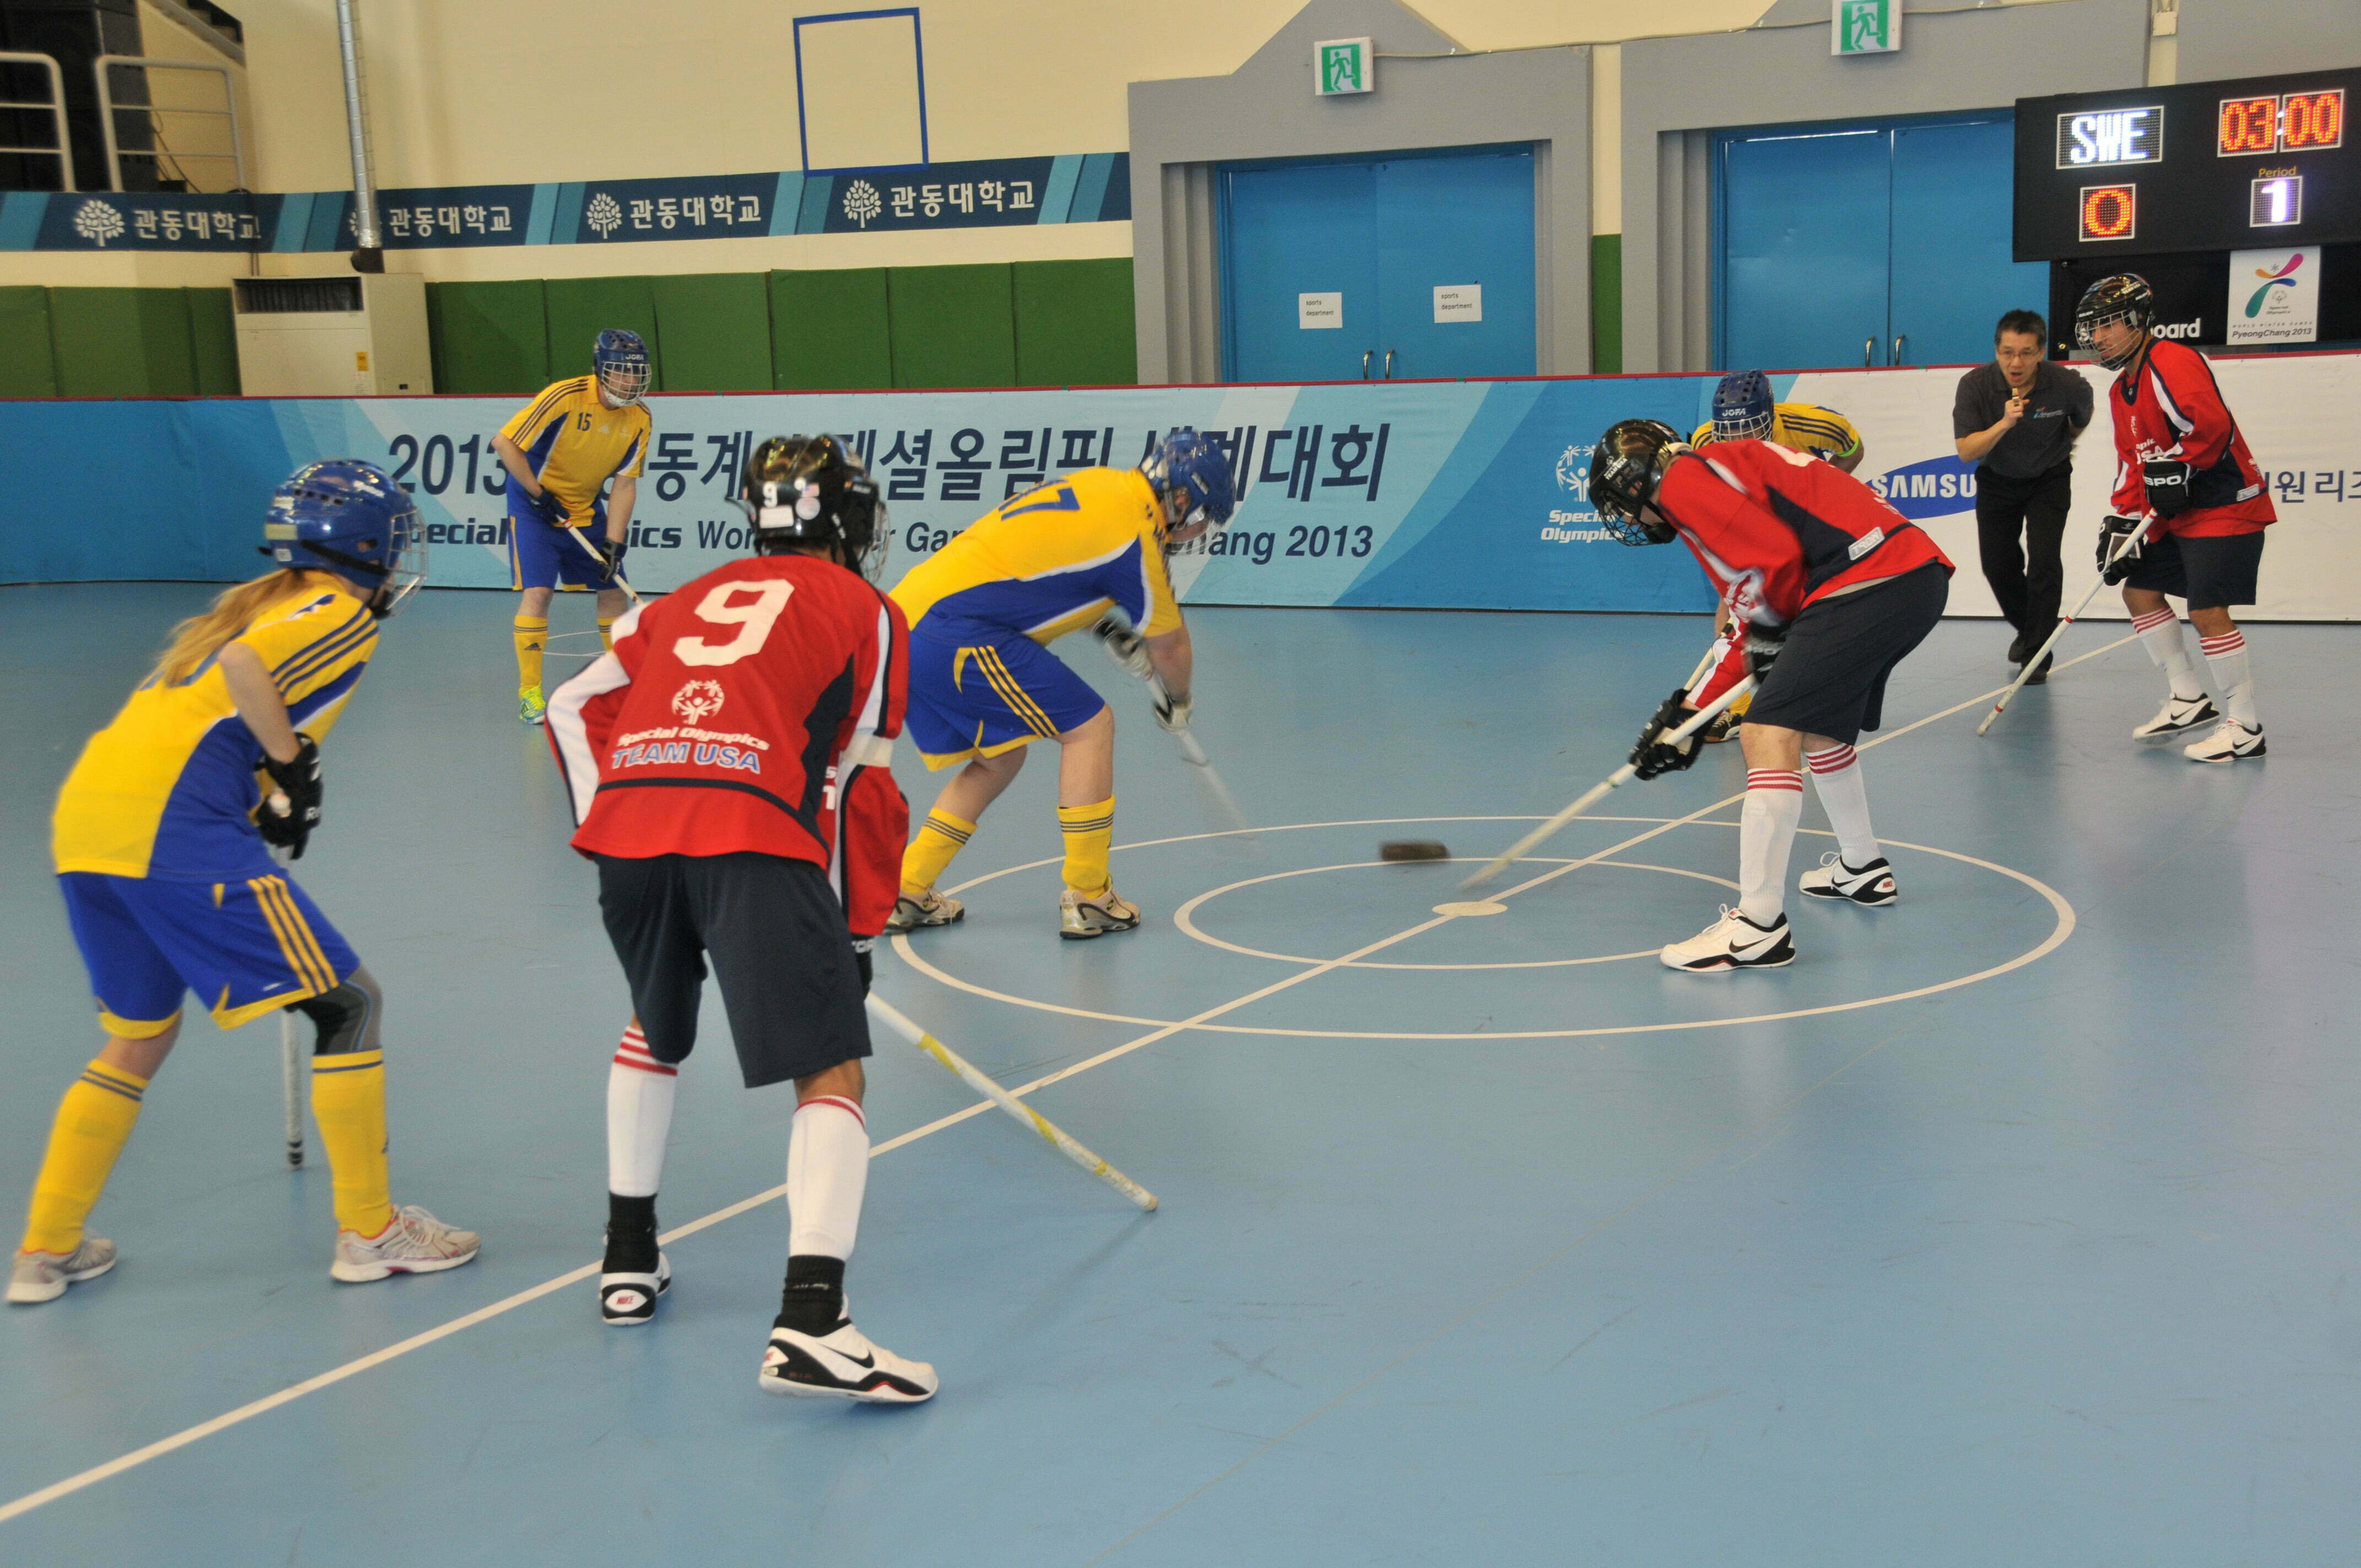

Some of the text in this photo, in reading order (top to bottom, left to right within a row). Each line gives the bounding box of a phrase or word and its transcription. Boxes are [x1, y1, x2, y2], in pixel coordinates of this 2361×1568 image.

[2070, 111, 2148, 163] SWE
[2221, 94, 2340, 150] 03:00
[2259, 166, 2297, 178] Period
[629, 195, 761, 230] 관동대학교
[891, 181, 1035, 218] 관동대학교
[2085, 188, 2132, 235] 0
[2261, 180, 2287, 222] 1
[132, 208, 262, 241] 관동대학교
[389, 205, 513, 238] 관동대학교
[1441, 303, 1473, 311] department
[2150, 318, 2201, 339] oard
[2232, 330, 2291, 339] PyeongChang
[577, 412, 592, 432] 15
[1722, 408, 1747, 417] JOFA
[763, 482, 777, 508] 9
[1872, 473, 1977, 498] SAMSU
[697, 521, 754, 549] Wor
[1286, 525, 1373, 557] 2013
[673, 579, 795, 666] 9
[617, 727, 770, 751] Special Olympics
[611, 742, 761, 775] TEAM USA
